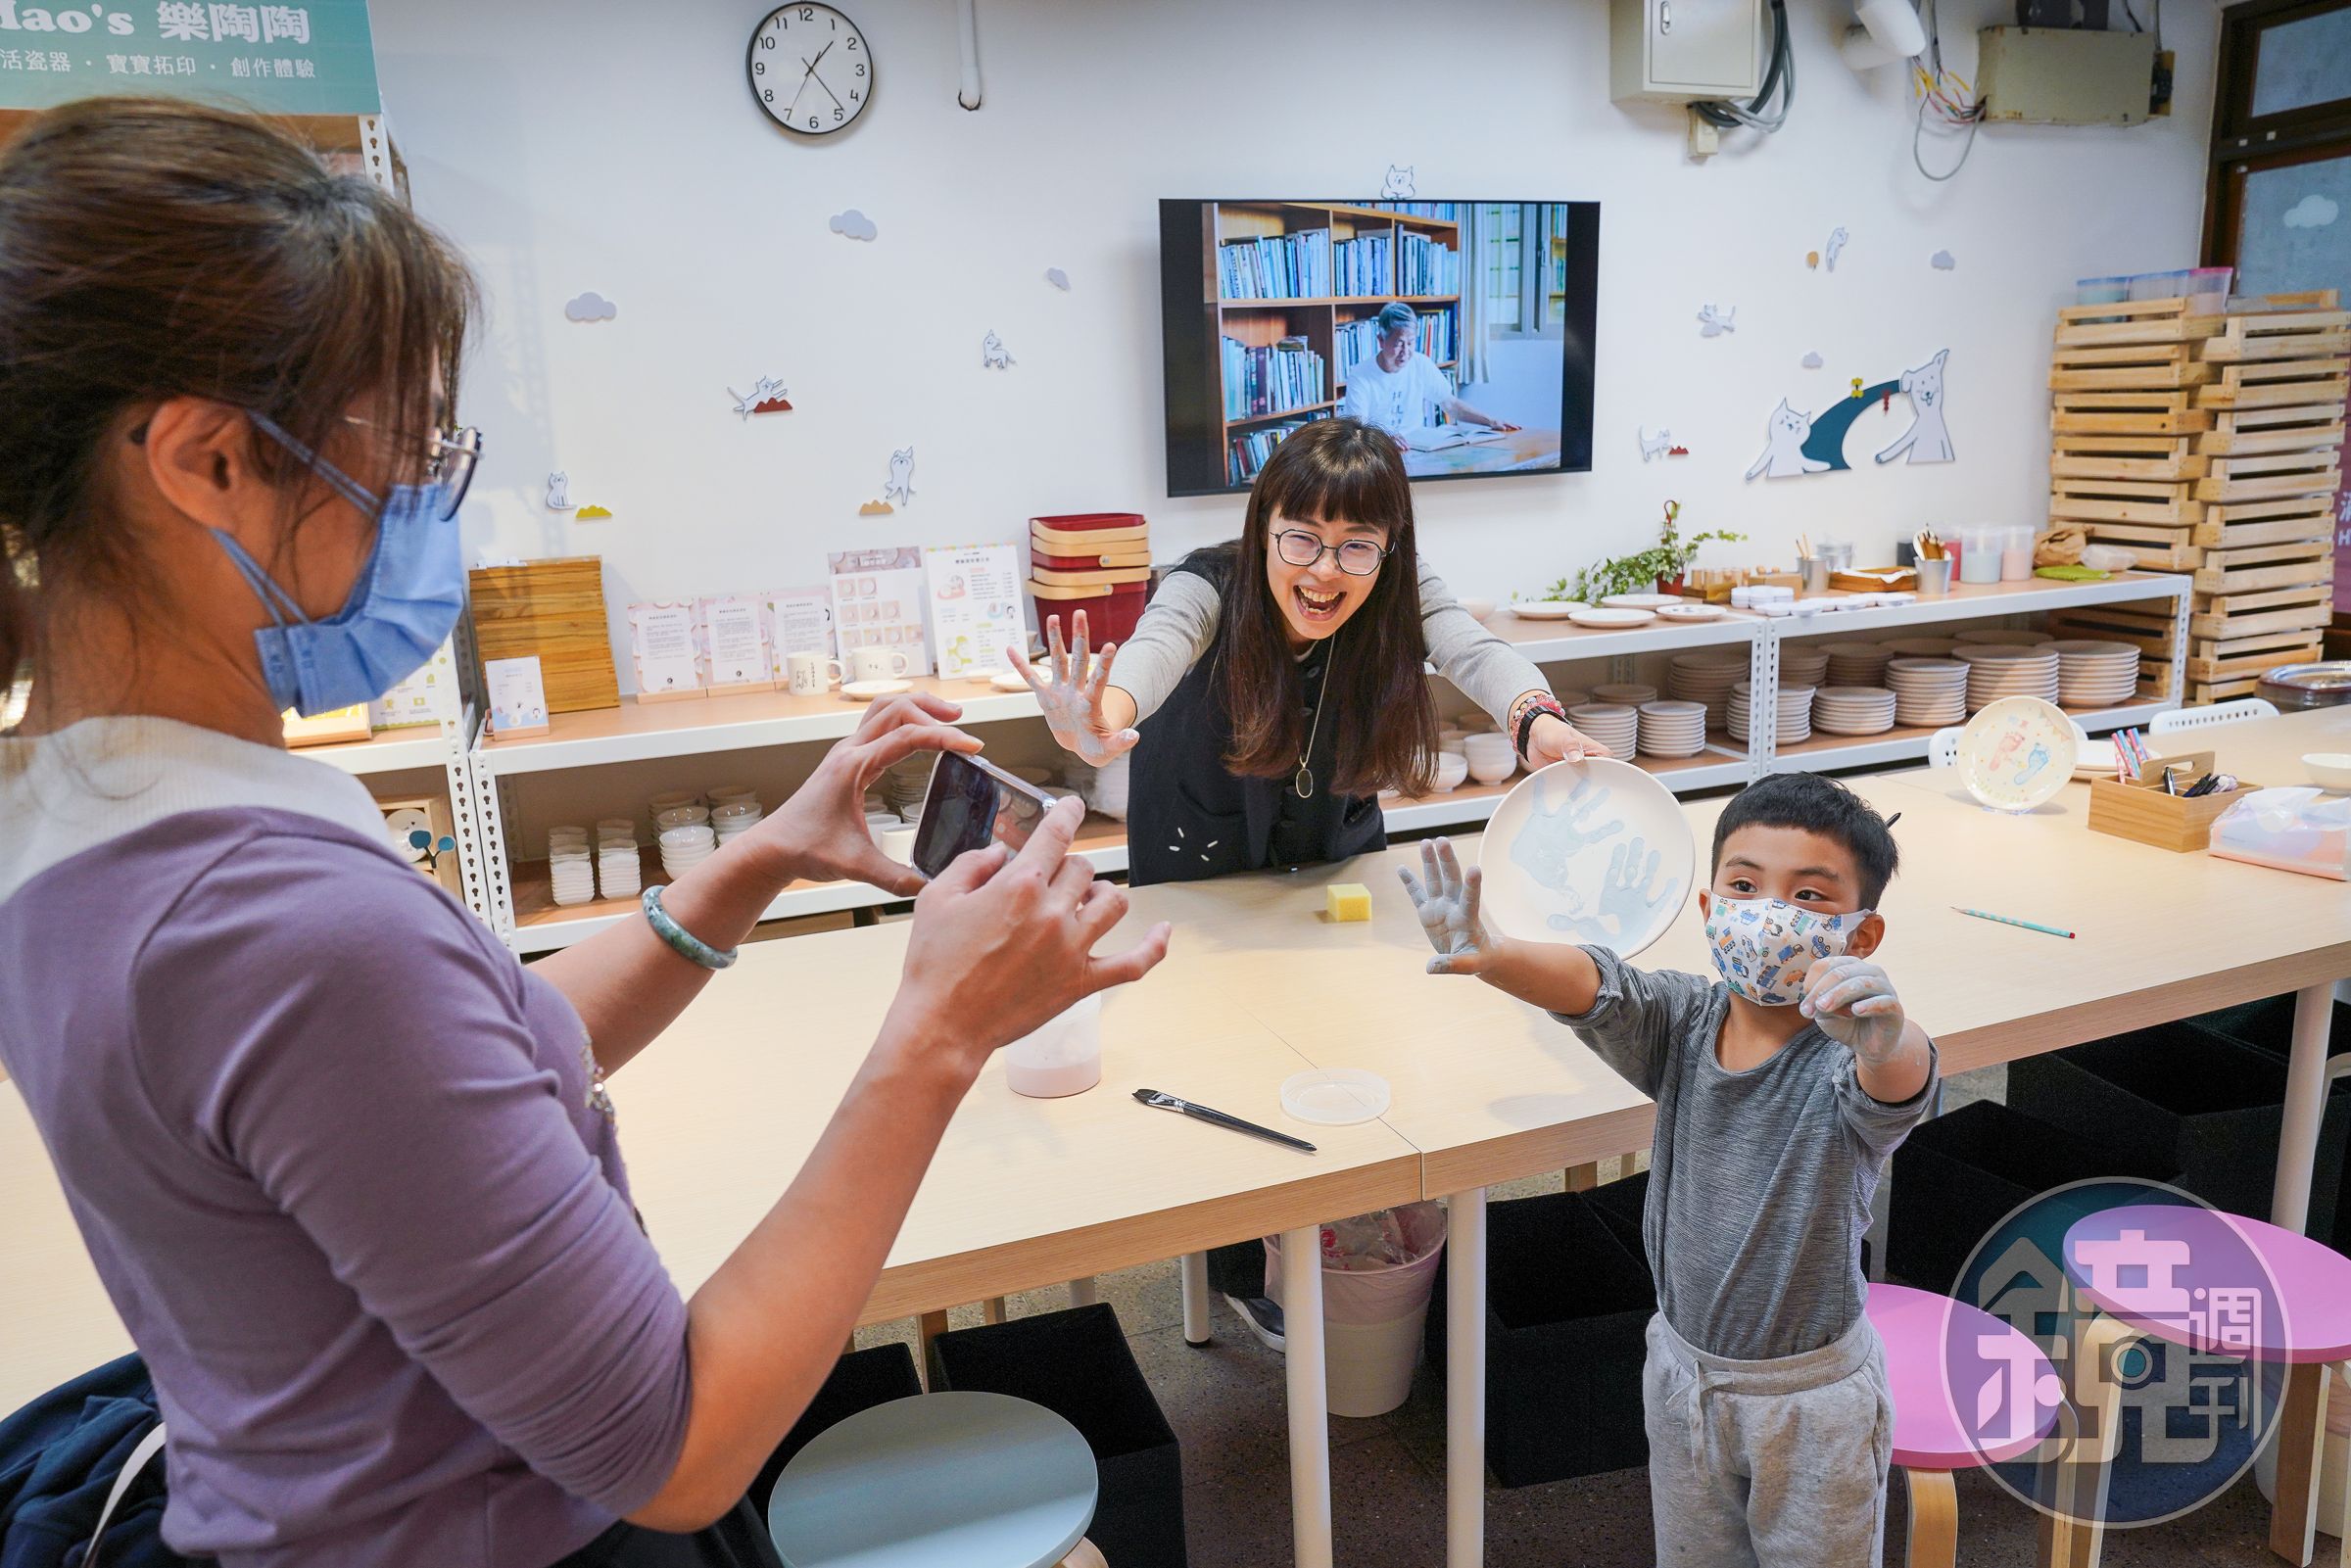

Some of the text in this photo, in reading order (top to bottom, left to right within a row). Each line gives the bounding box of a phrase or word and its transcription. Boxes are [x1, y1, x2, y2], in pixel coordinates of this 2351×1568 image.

[798, 8, 814, 22] 12
[157, 1, 311, 44] 樂陶陶
[775, 17, 788, 30] 11
[830, 19, 836, 30] 1
[759, 36, 776, 50] 10
[846, 37, 857, 51] 2
[106, 53, 196, 76] 寶寶拓印
[230, 57, 315, 78] 創作體驗
[755, 62, 765, 75] 9
[855, 64, 865, 76] 3
[764, 89, 774, 102] 8
[849, 89, 859, 102] 4
[784, 108, 792, 121] 7
[834, 109, 843, 121] 5
[809, 117, 819, 129] 6
